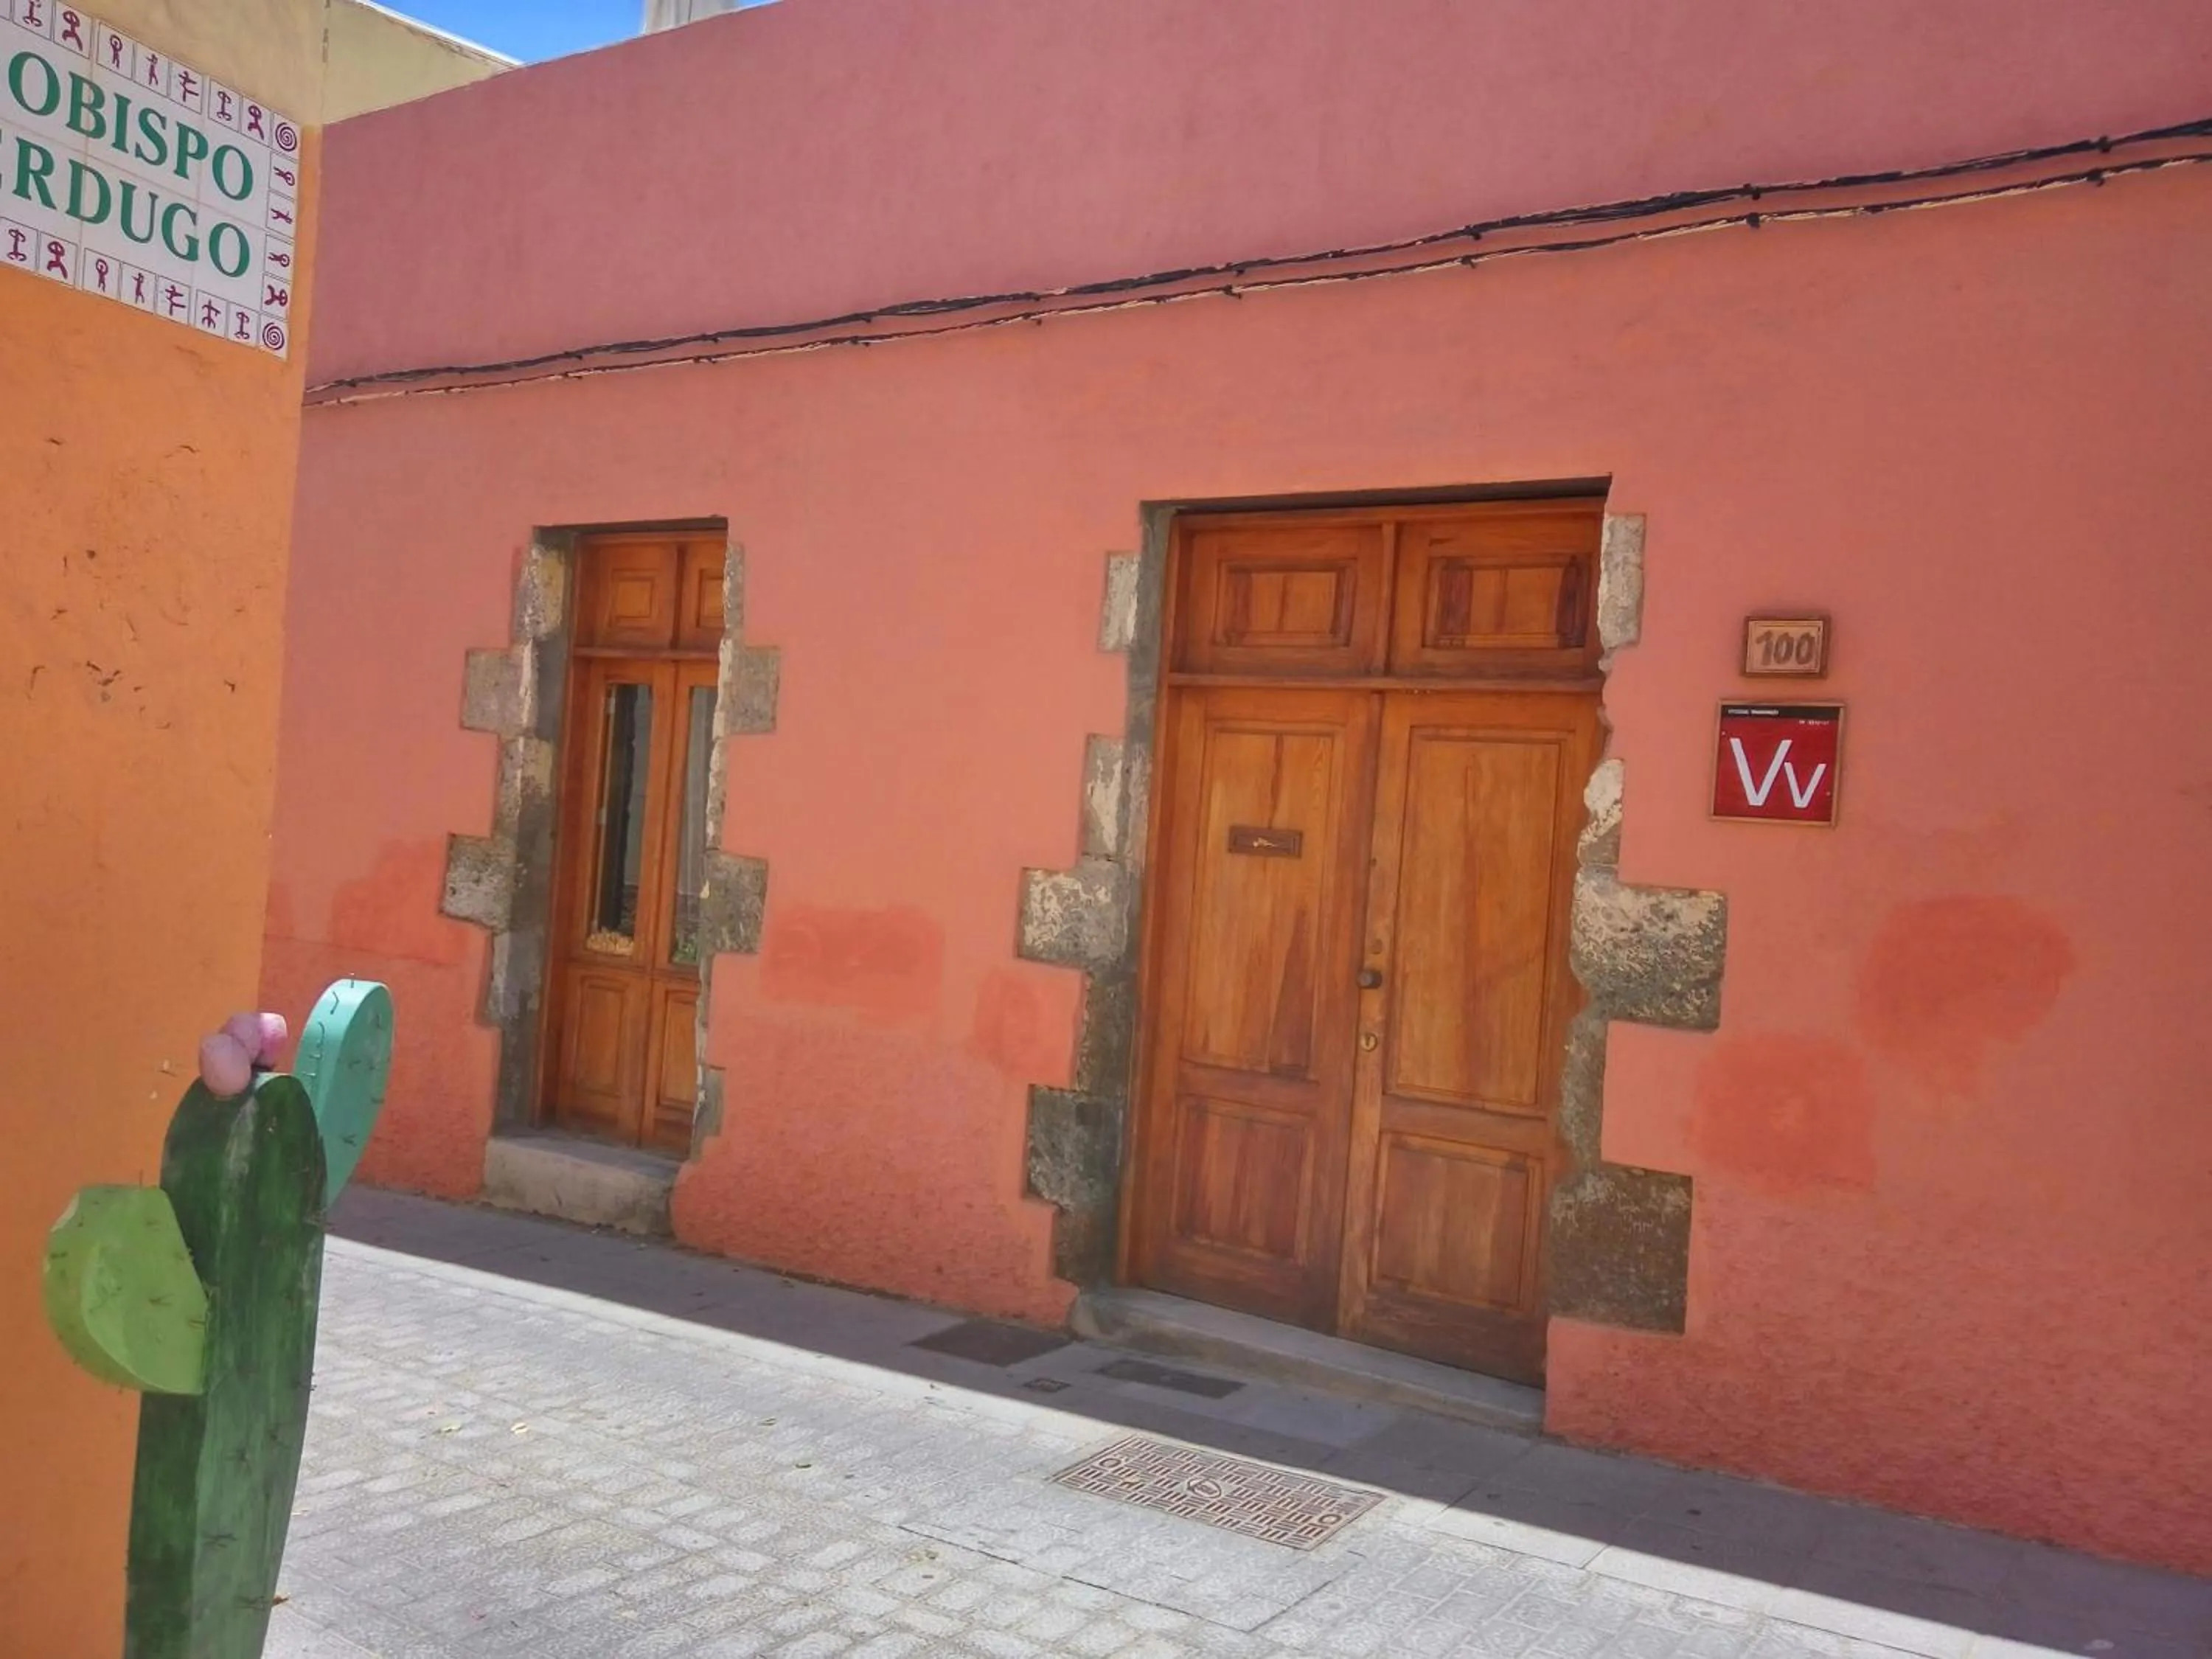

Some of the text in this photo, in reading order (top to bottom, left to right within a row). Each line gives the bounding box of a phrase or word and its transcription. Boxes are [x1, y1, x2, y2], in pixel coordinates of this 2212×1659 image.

[8, 51, 254, 201] OBISPO
[0, 128, 250, 278] RDUGO
[1756, 630, 1815, 665] 100
